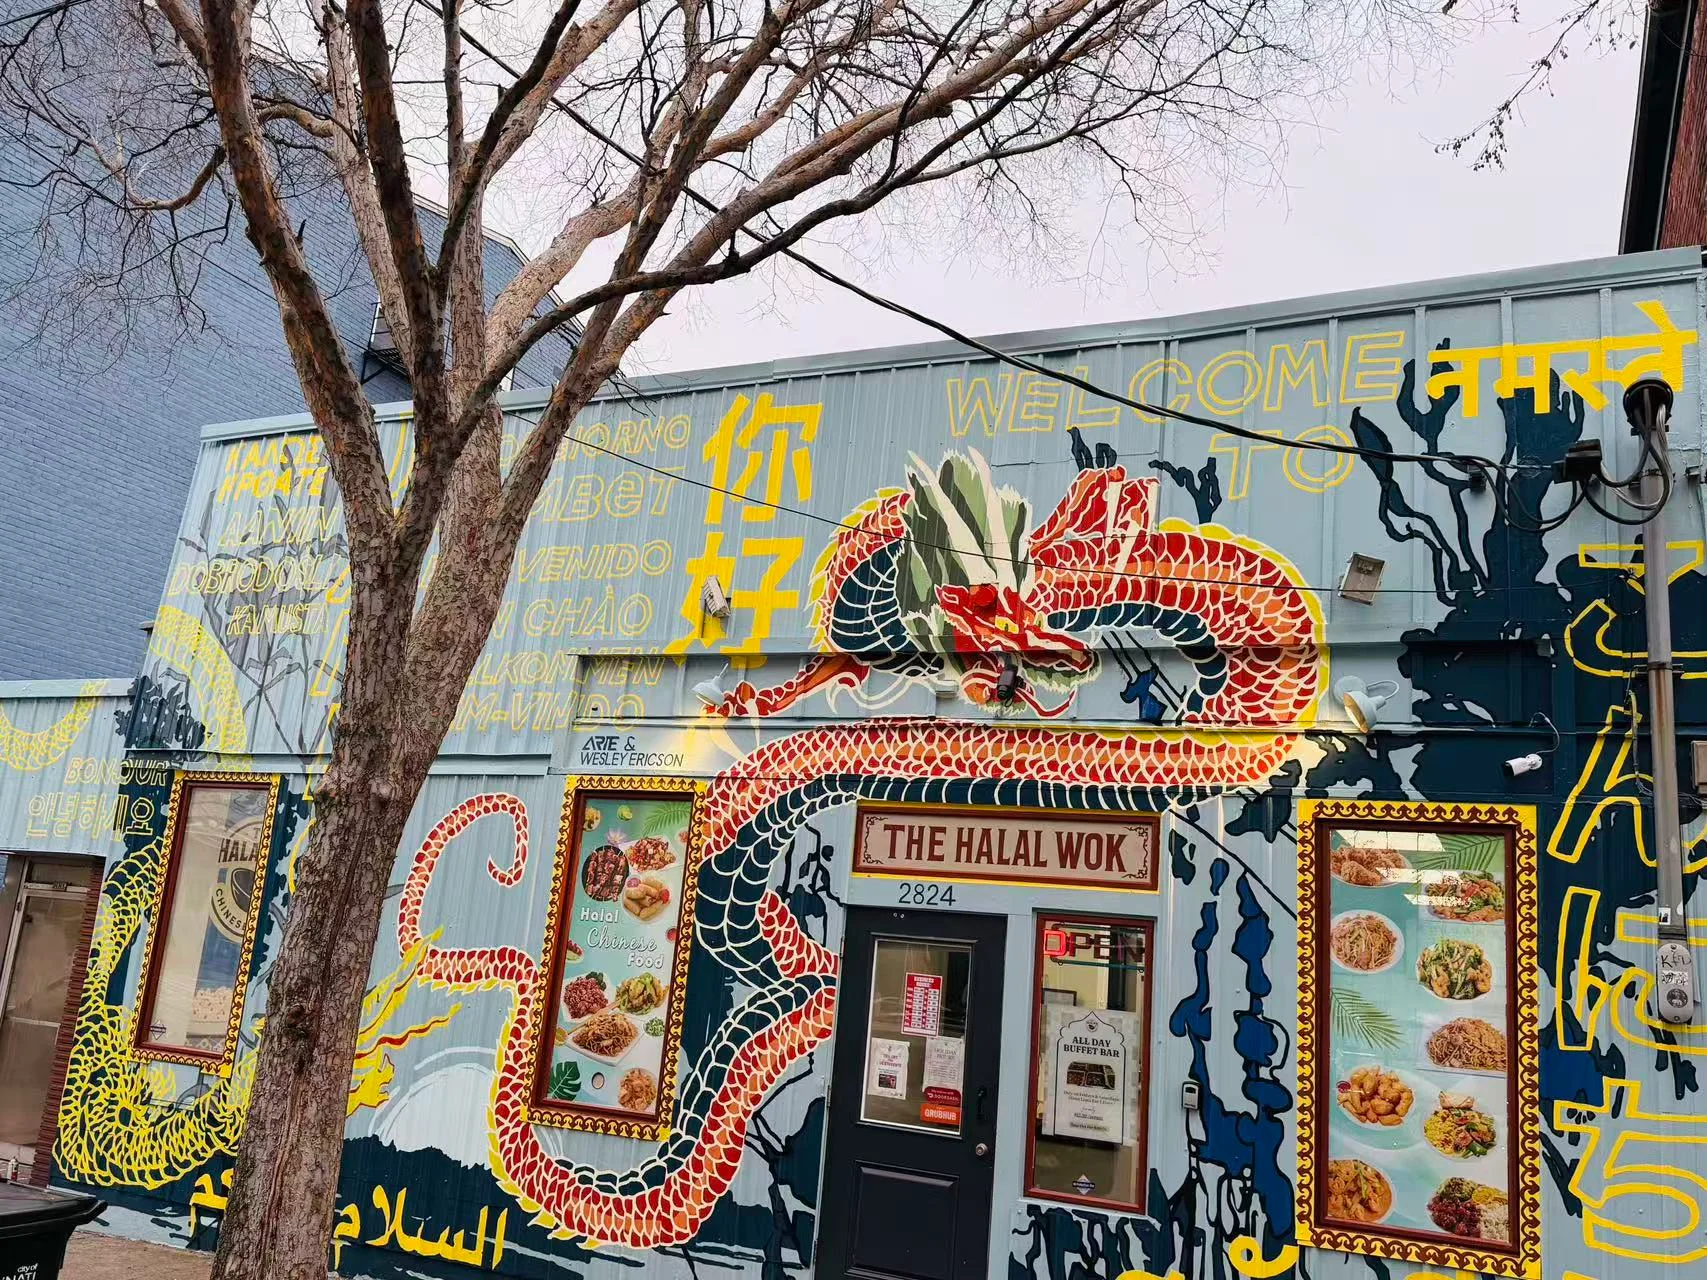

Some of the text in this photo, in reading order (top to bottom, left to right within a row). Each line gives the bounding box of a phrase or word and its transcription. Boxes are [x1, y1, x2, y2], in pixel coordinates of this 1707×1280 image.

[946, 330, 1405, 438] WELCOME
[1207, 424, 1356, 501] TO
[663, 392, 824, 670] 你好
[227, 602, 329, 636] KAMUSTA
[624, 735, 636, 752] &
[64, 757, 170, 786] BONJOUR
[580, 751, 685, 767] WESLEY ERICSON
[218, 837, 261, 863] HALA
[883, 823, 1128, 873] THE HALAL WOK
[898, 882, 956, 907] 2824
[580, 907, 619, 924] Halal
[587, 925, 658, 952] Chinese
[1043, 928, 1145, 963] OPEN
[627, 952, 665, 969] Food
[1063, 1043, 1120, 1058] BUFFET BAR
[1072, 1036, 1111, 1048] ALL DAY
[333, 1184, 508, 1271] السلام
